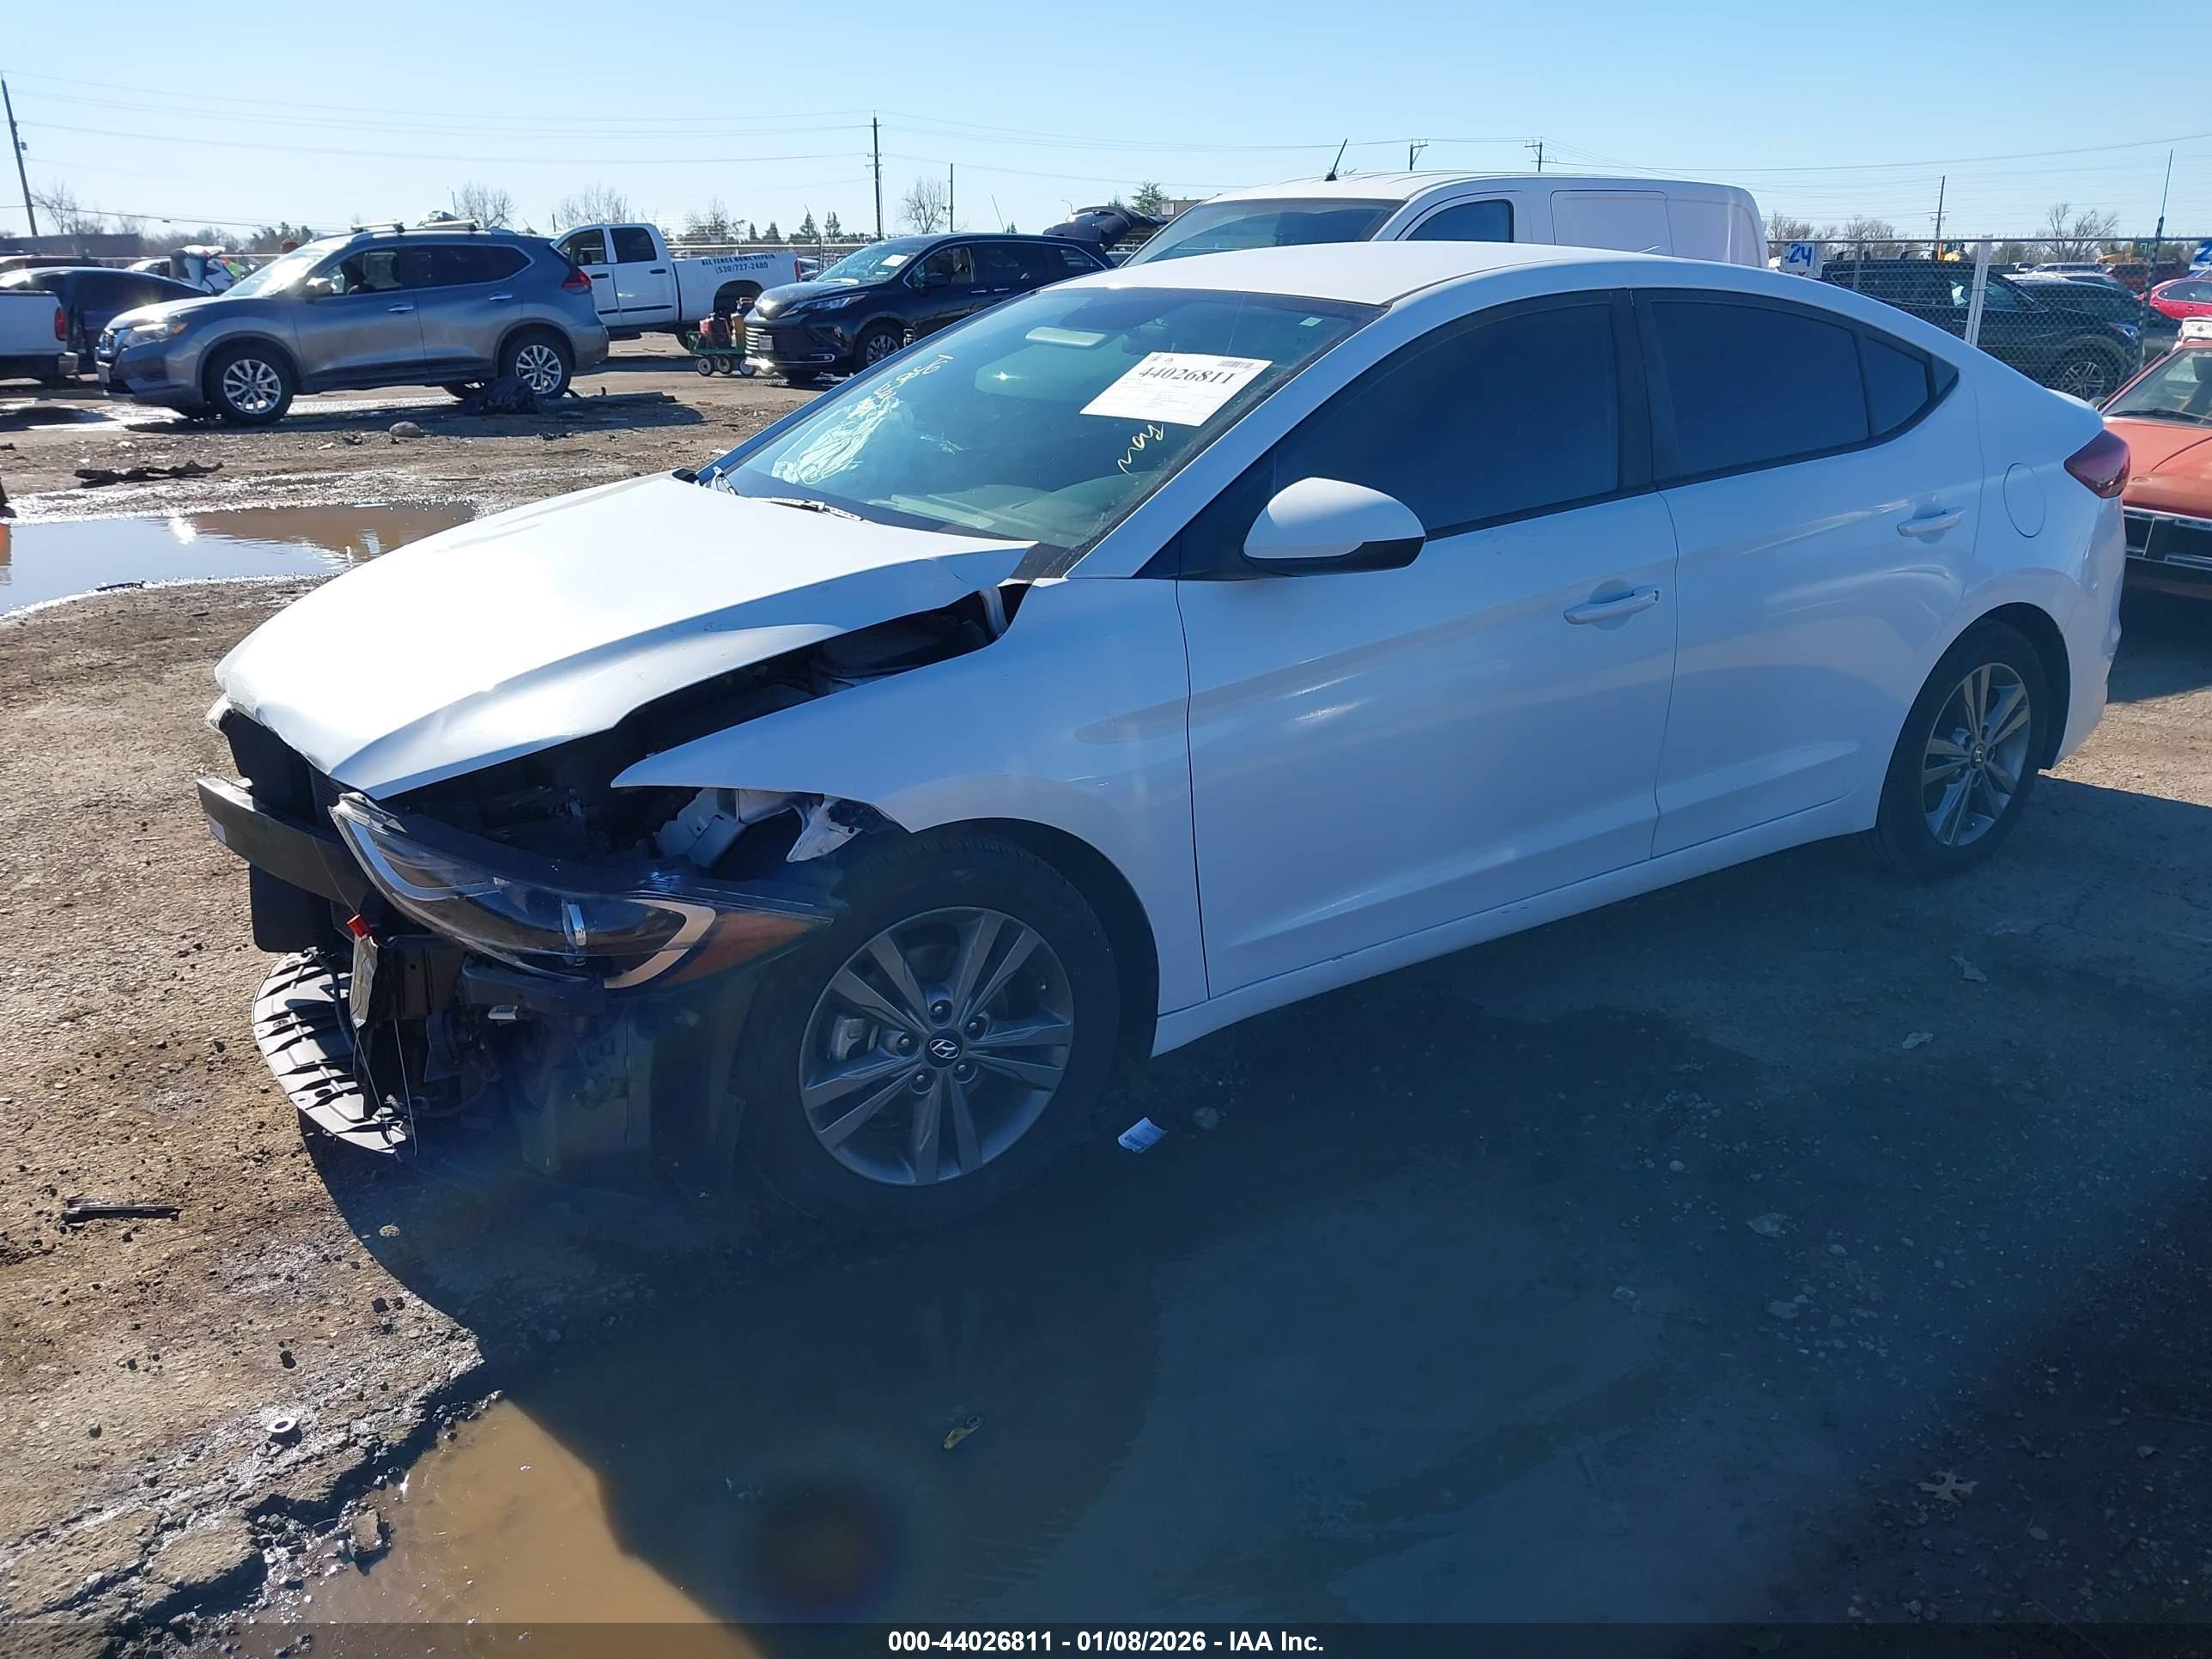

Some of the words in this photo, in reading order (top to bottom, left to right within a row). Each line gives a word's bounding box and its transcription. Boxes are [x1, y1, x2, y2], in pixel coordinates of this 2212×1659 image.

[1790, 244, 1812, 267] 24
[2194, 240, 2212, 263] 2
[1139, 366, 1237, 385] 44026811
